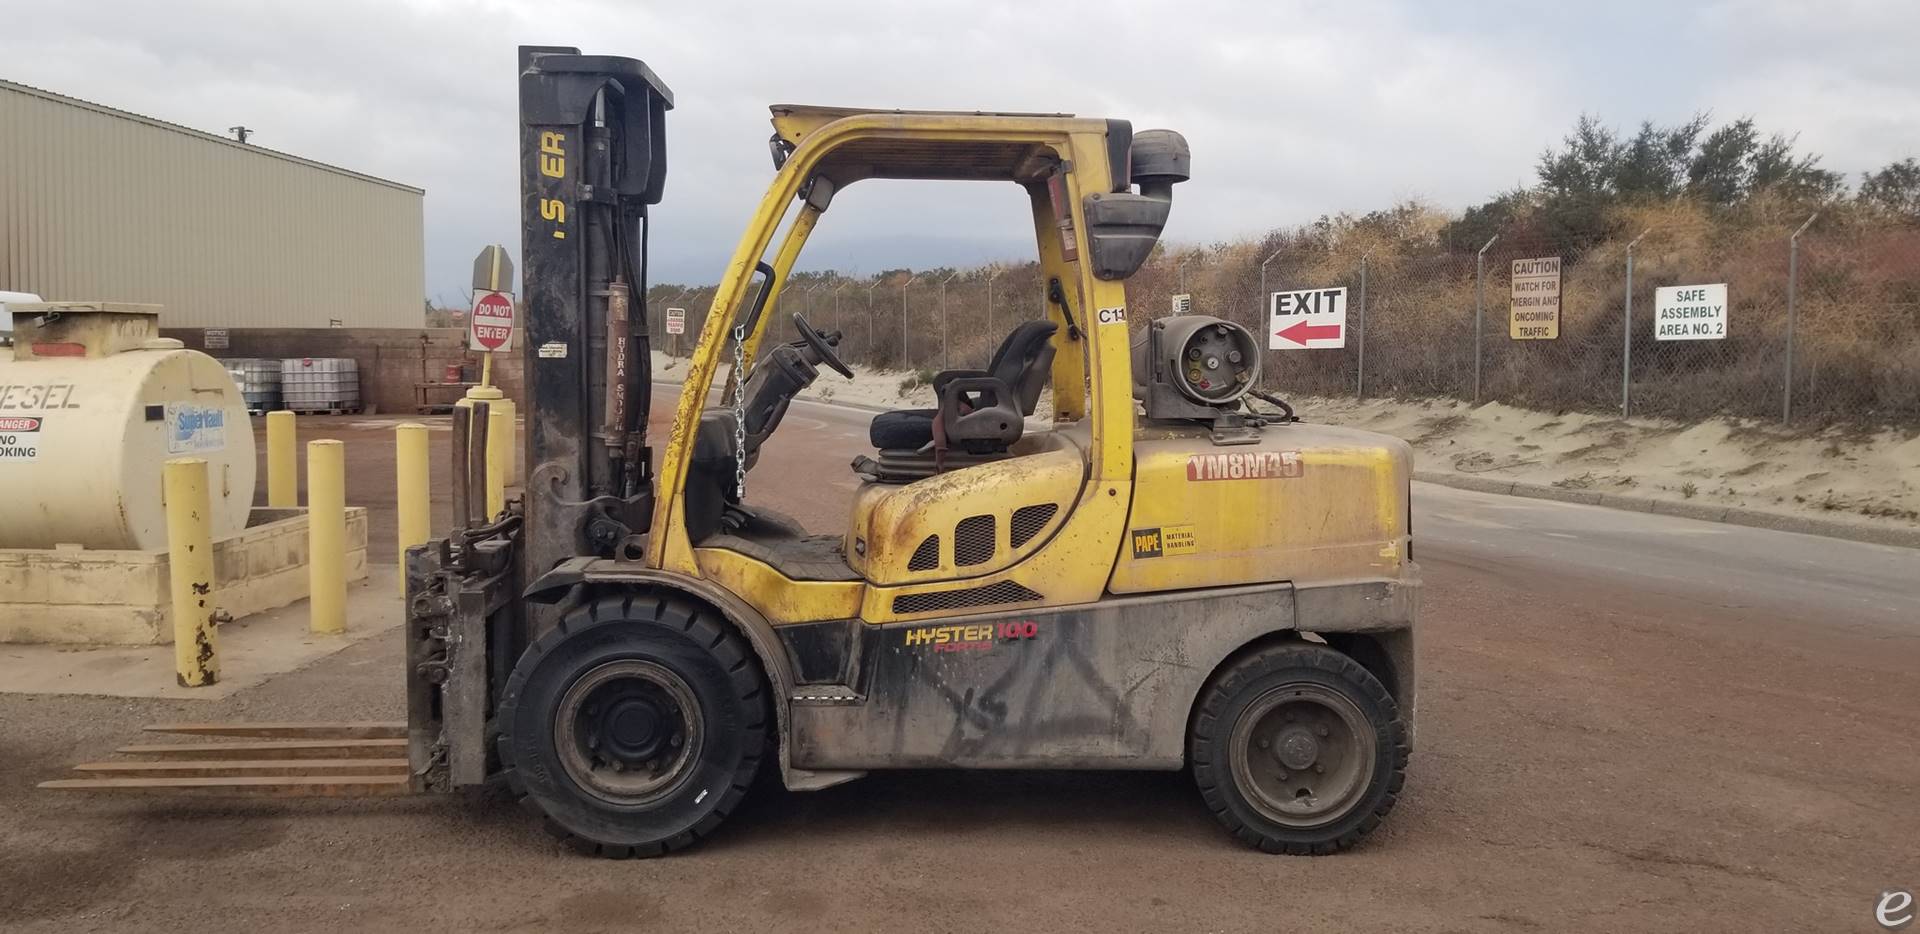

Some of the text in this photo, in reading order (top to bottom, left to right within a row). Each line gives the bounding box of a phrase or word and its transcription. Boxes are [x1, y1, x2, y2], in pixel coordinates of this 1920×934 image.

[1514, 261, 1559, 274] CAUTION
[1515, 281, 1556, 292] WATCH FOR
[1276, 290, 1341, 315] EXIT
[1513, 296, 1558, 307] MERGIN AND
[1676, 290, 1706, 302] SAFE
[478, 303, 511, 317] DO NOT
[1660, 305, 1722, 319] ASSEMBLY
[1514, 312, 1554, 322] ONCOMING
[477, 327, 508, 340] ENTER
[1519, 327, 1549, 337] TRAFFIC
[1660, 322, 1723, 335] AREA NO. 2
[617, 338, 626, 376] HYDRA
[0, 385, 80, 409] ESEL
[0, 435, 17, 446] NO
[1190, 452, 1297, 479] YM8M45
[1166, 532, 1194, 540] MATERIAL
[1166, 540, 1195, 549] HANDLING
[905, 621, 1037, 646] HYSTER 100
